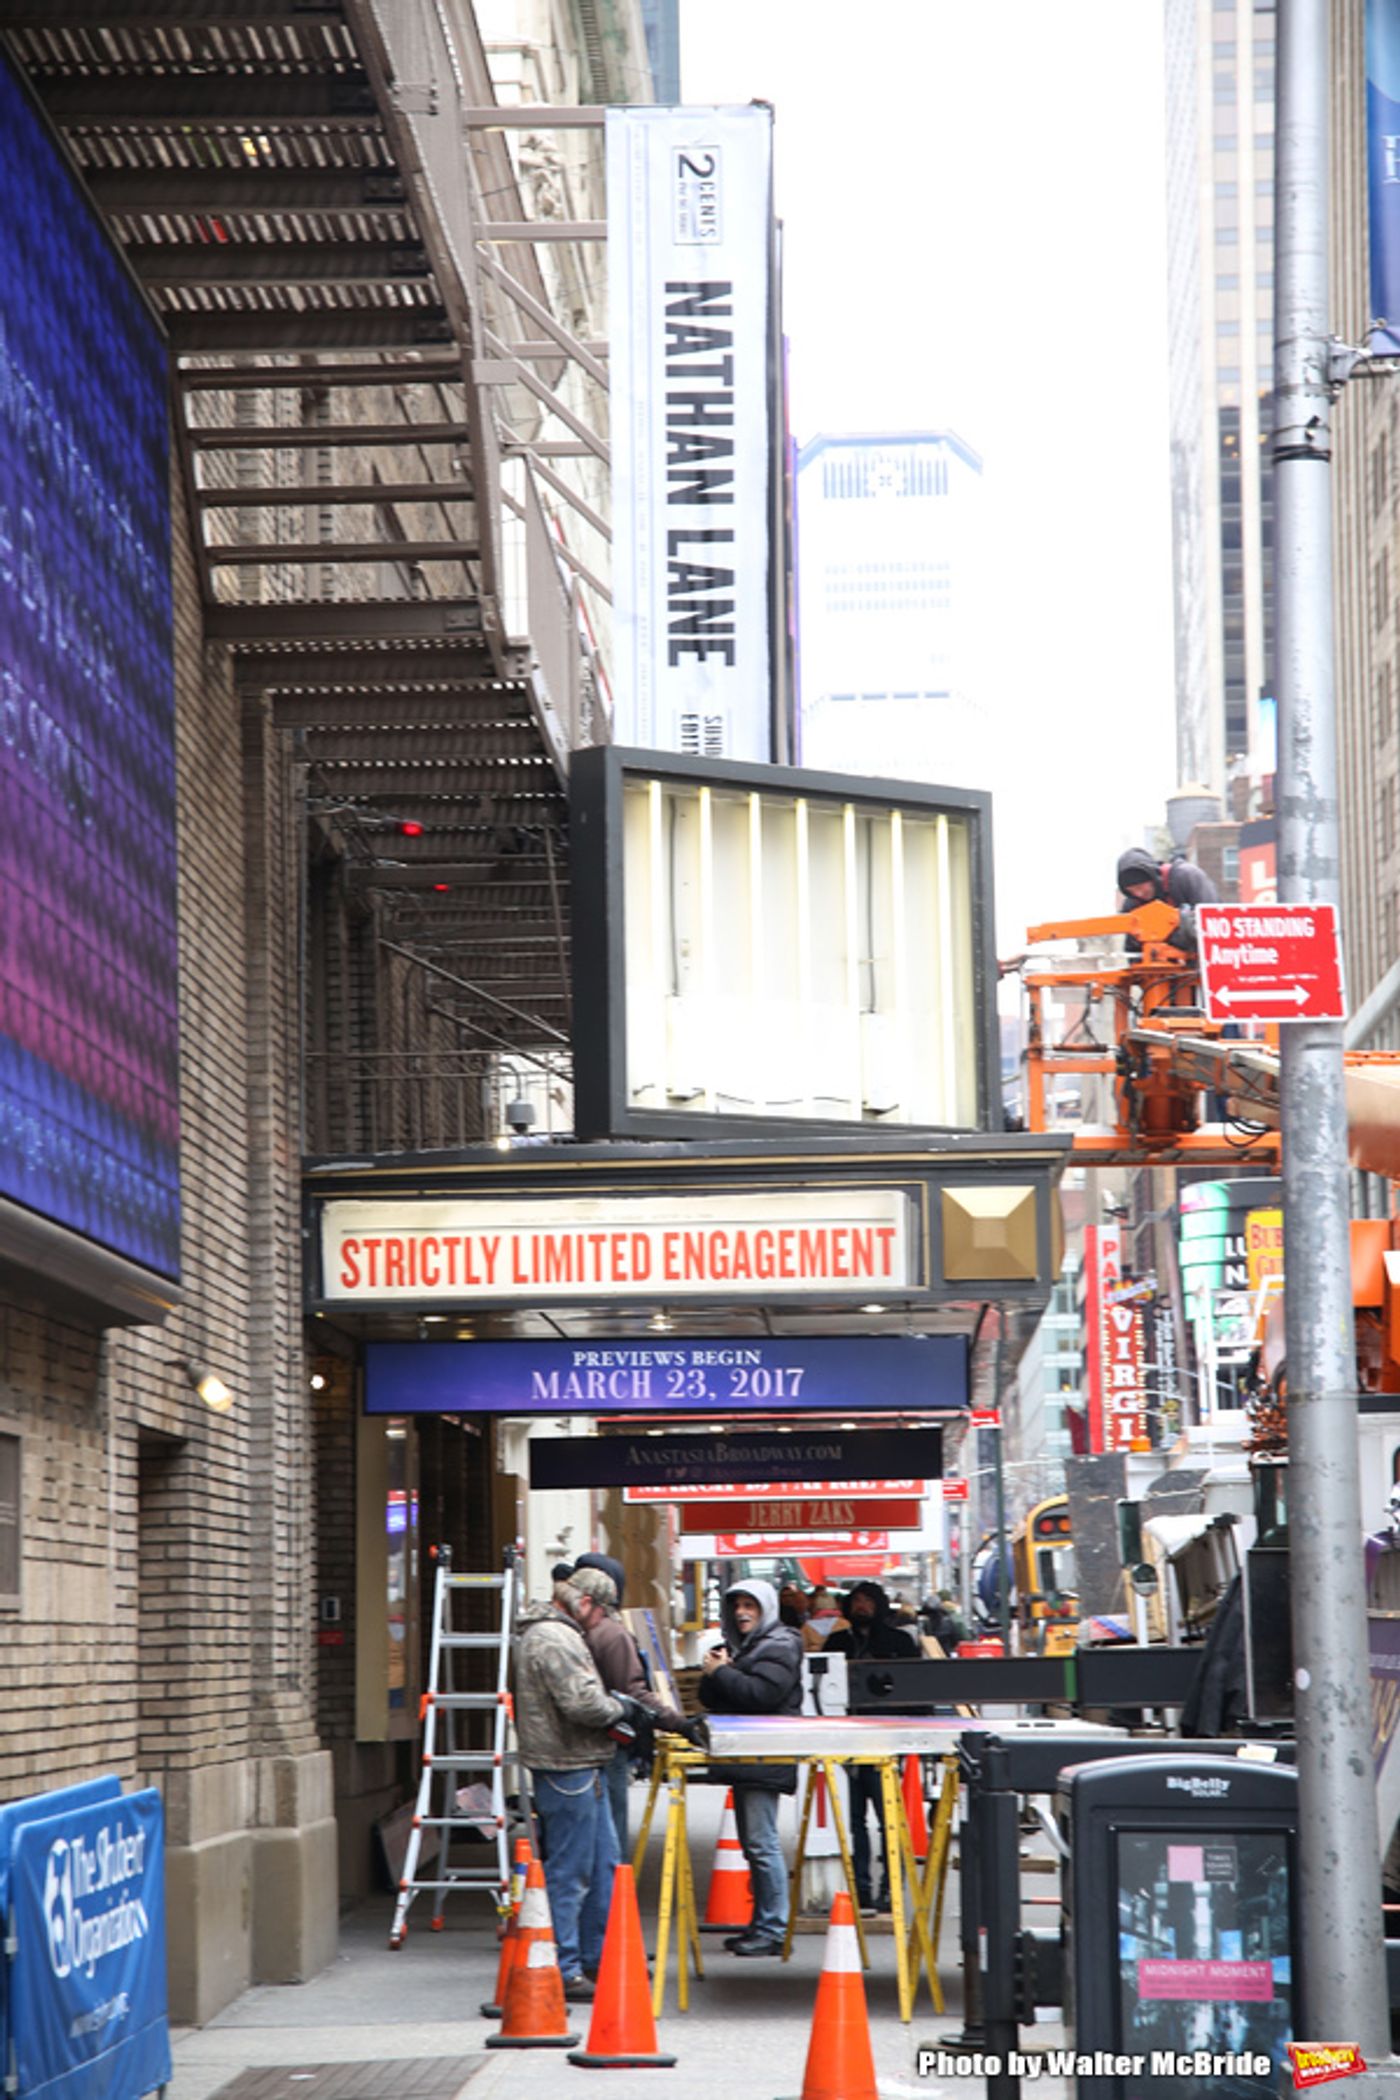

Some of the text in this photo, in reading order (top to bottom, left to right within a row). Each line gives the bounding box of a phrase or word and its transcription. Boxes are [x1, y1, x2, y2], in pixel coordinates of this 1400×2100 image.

[678, 154, 717, 238] 2 CENTS
[664, 281, 736, 667] NATHAN LANE
[1205, 916, 1316, 939] NO STANDING
[1210, 943, 1279, 970] Anytime
[340, 1227, 897, 1290] STRICTLY LIMITED ENGAGEMENT
[572, 1349, 762, 1367] PREVIEWS BEGIN
[531, 1367, 805, 1401] MARCH 23, 2017
[746, 1500, 856, 1527] JERRY ZAKS
[1166, 1776, 1232, 1791] BigBelly
[70, 1834, 97, 1899] The
[1145, 1964, 1267, 1978] MIDNIGHT MOMENT
